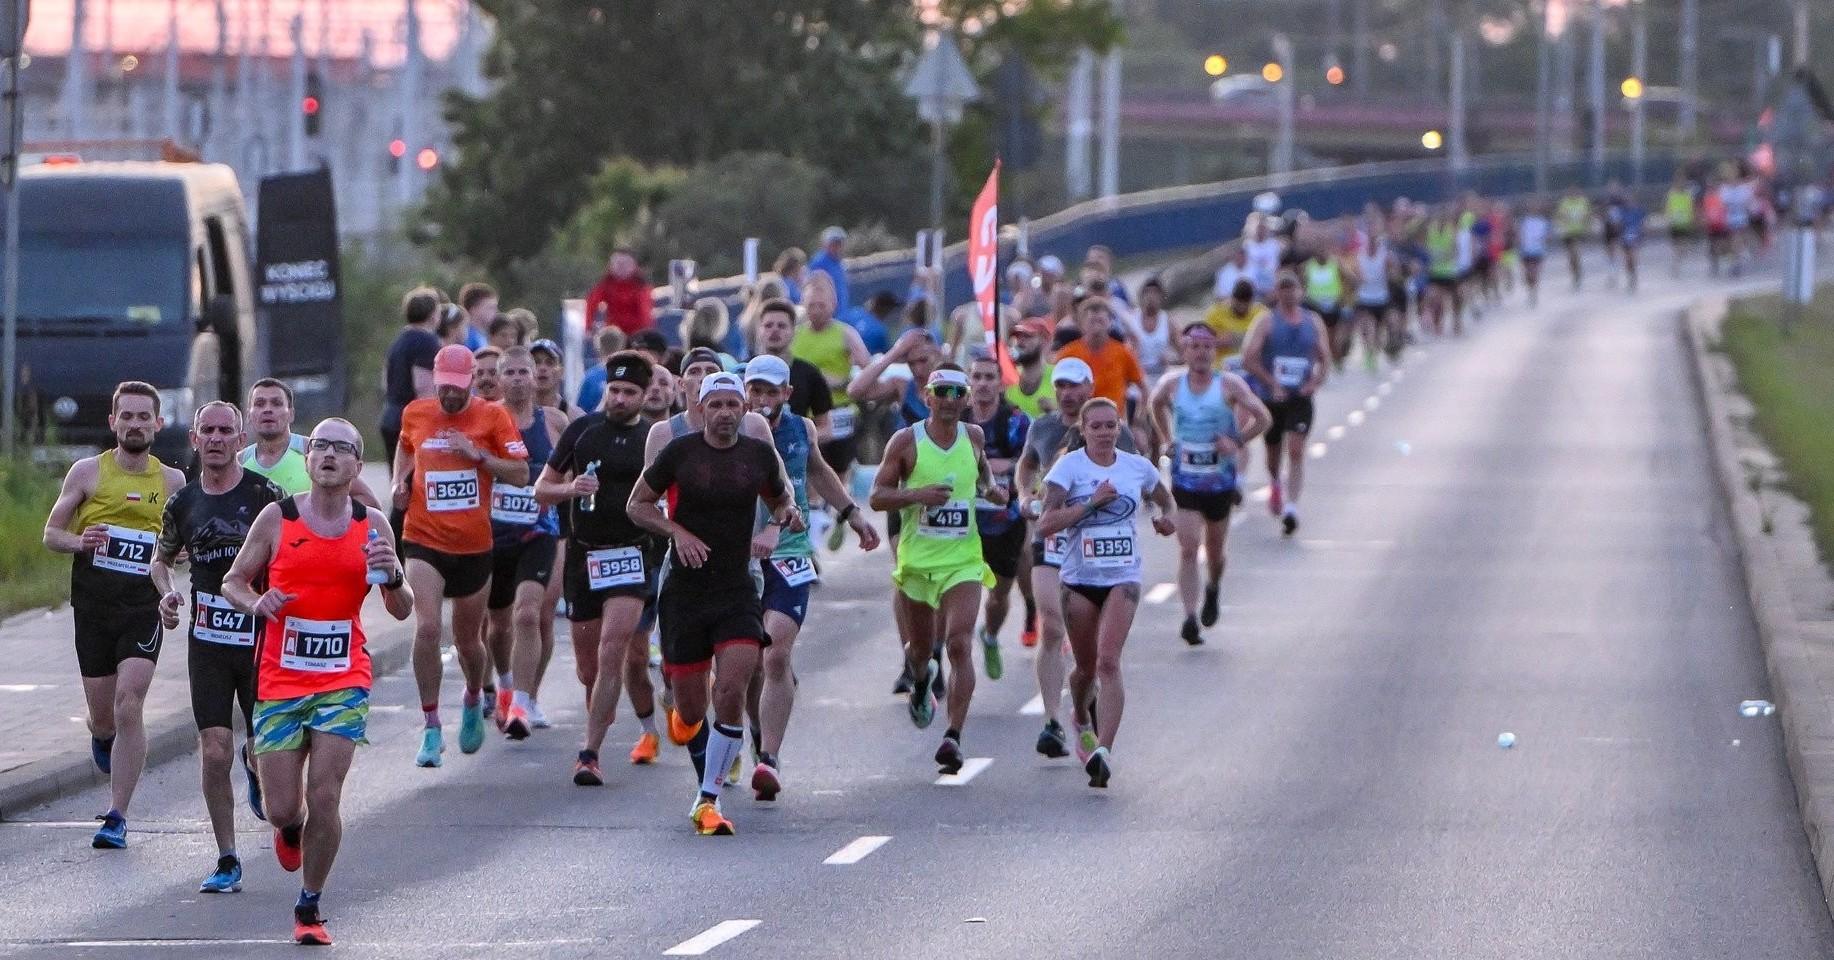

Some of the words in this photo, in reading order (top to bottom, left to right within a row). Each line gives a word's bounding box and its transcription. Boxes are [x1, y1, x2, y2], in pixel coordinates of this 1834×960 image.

[265, 260, 329, 281] KONIEC
[438, 482, 476, 498] 3620
[936, 511, 962, 525] 419
[118, 541, 144, 560] 712
[1095, 540, 1131, 555] 3359
[601, 558, 640, 576] 3958
[212, 611, 245, 630] 647
[304, 636, 343, 656] 1710
